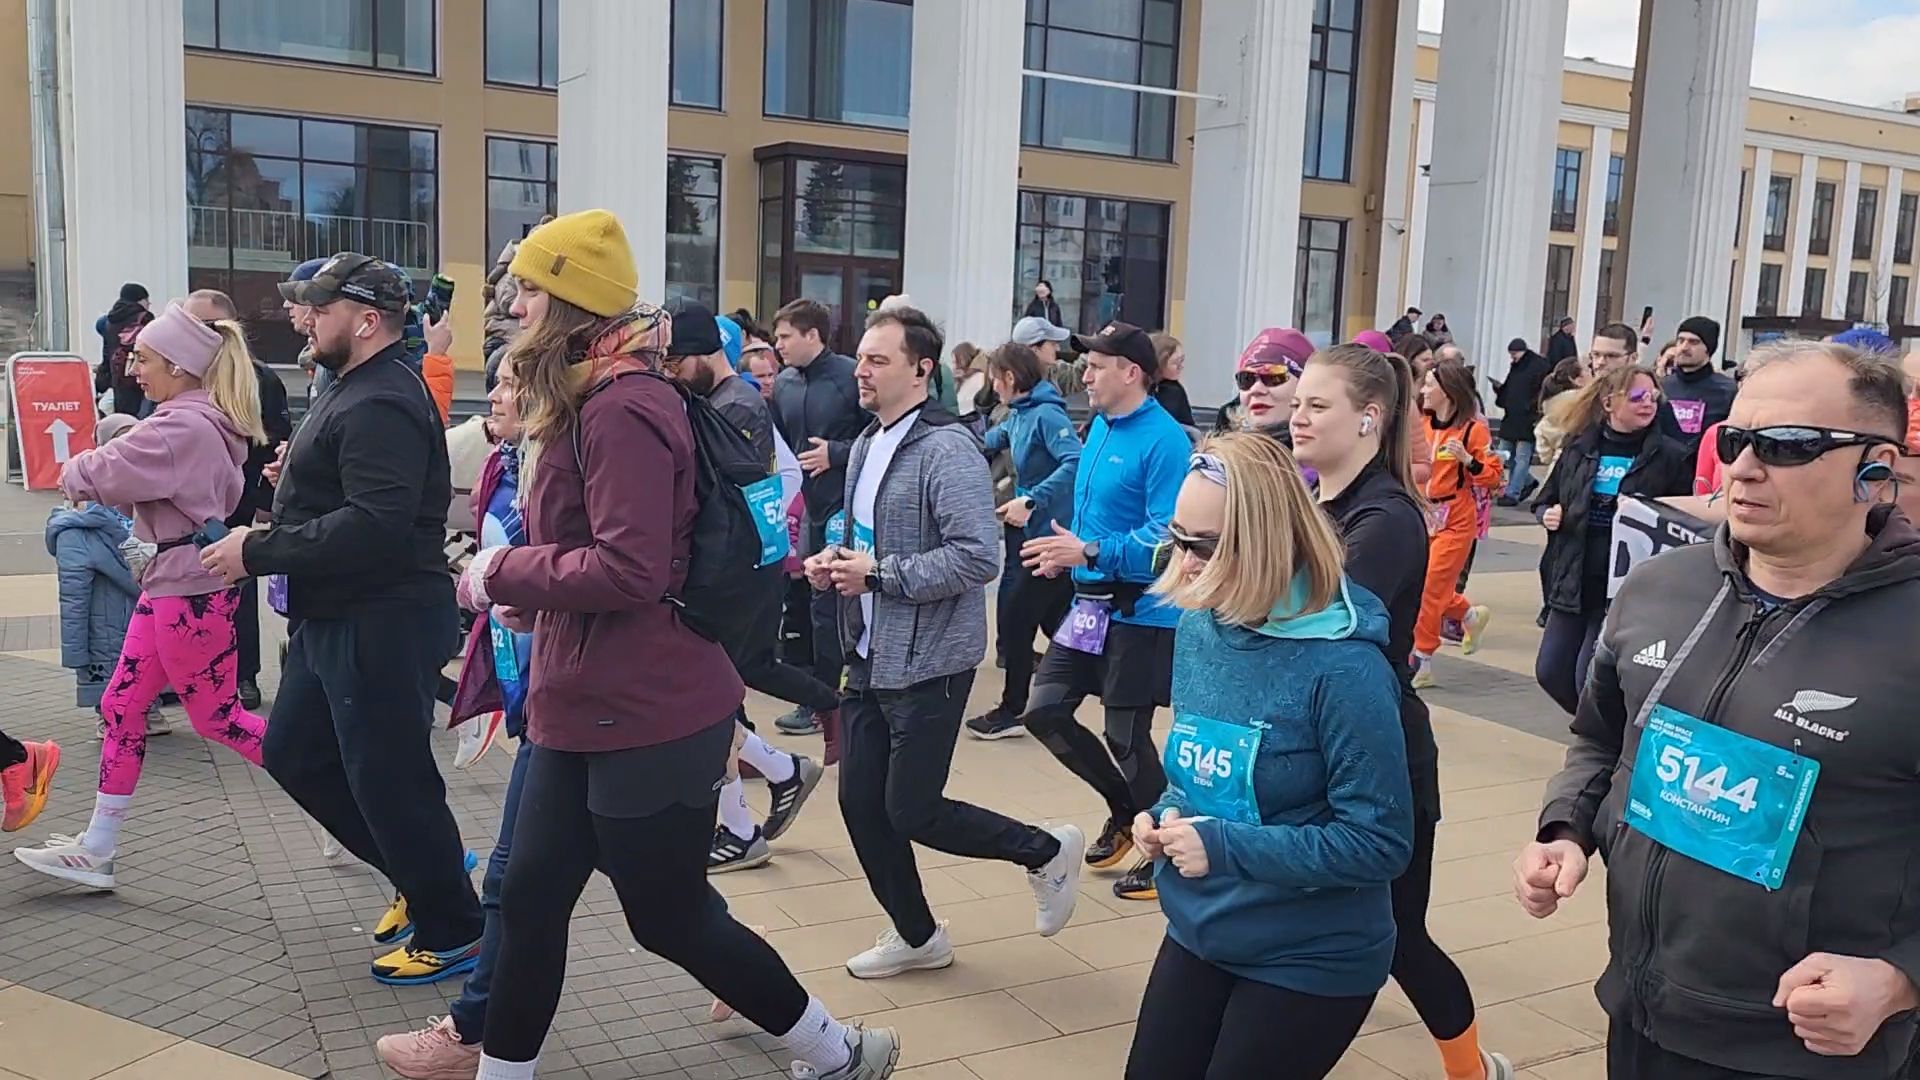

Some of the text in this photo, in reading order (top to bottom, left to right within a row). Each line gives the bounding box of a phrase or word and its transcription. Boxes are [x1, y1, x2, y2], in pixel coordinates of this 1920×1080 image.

[32, 401, 80, 412] ТУАЛЕТ
[1633, 653, 1668, 669] adidas
[1773, 708, 1844, 741] ALL BLACKS
[1177, 740, 1232, 778] 5145
[1656, 744, 1759, 813] 5144
[1659, 789, 1731, 826] КОНСТАНТИН
